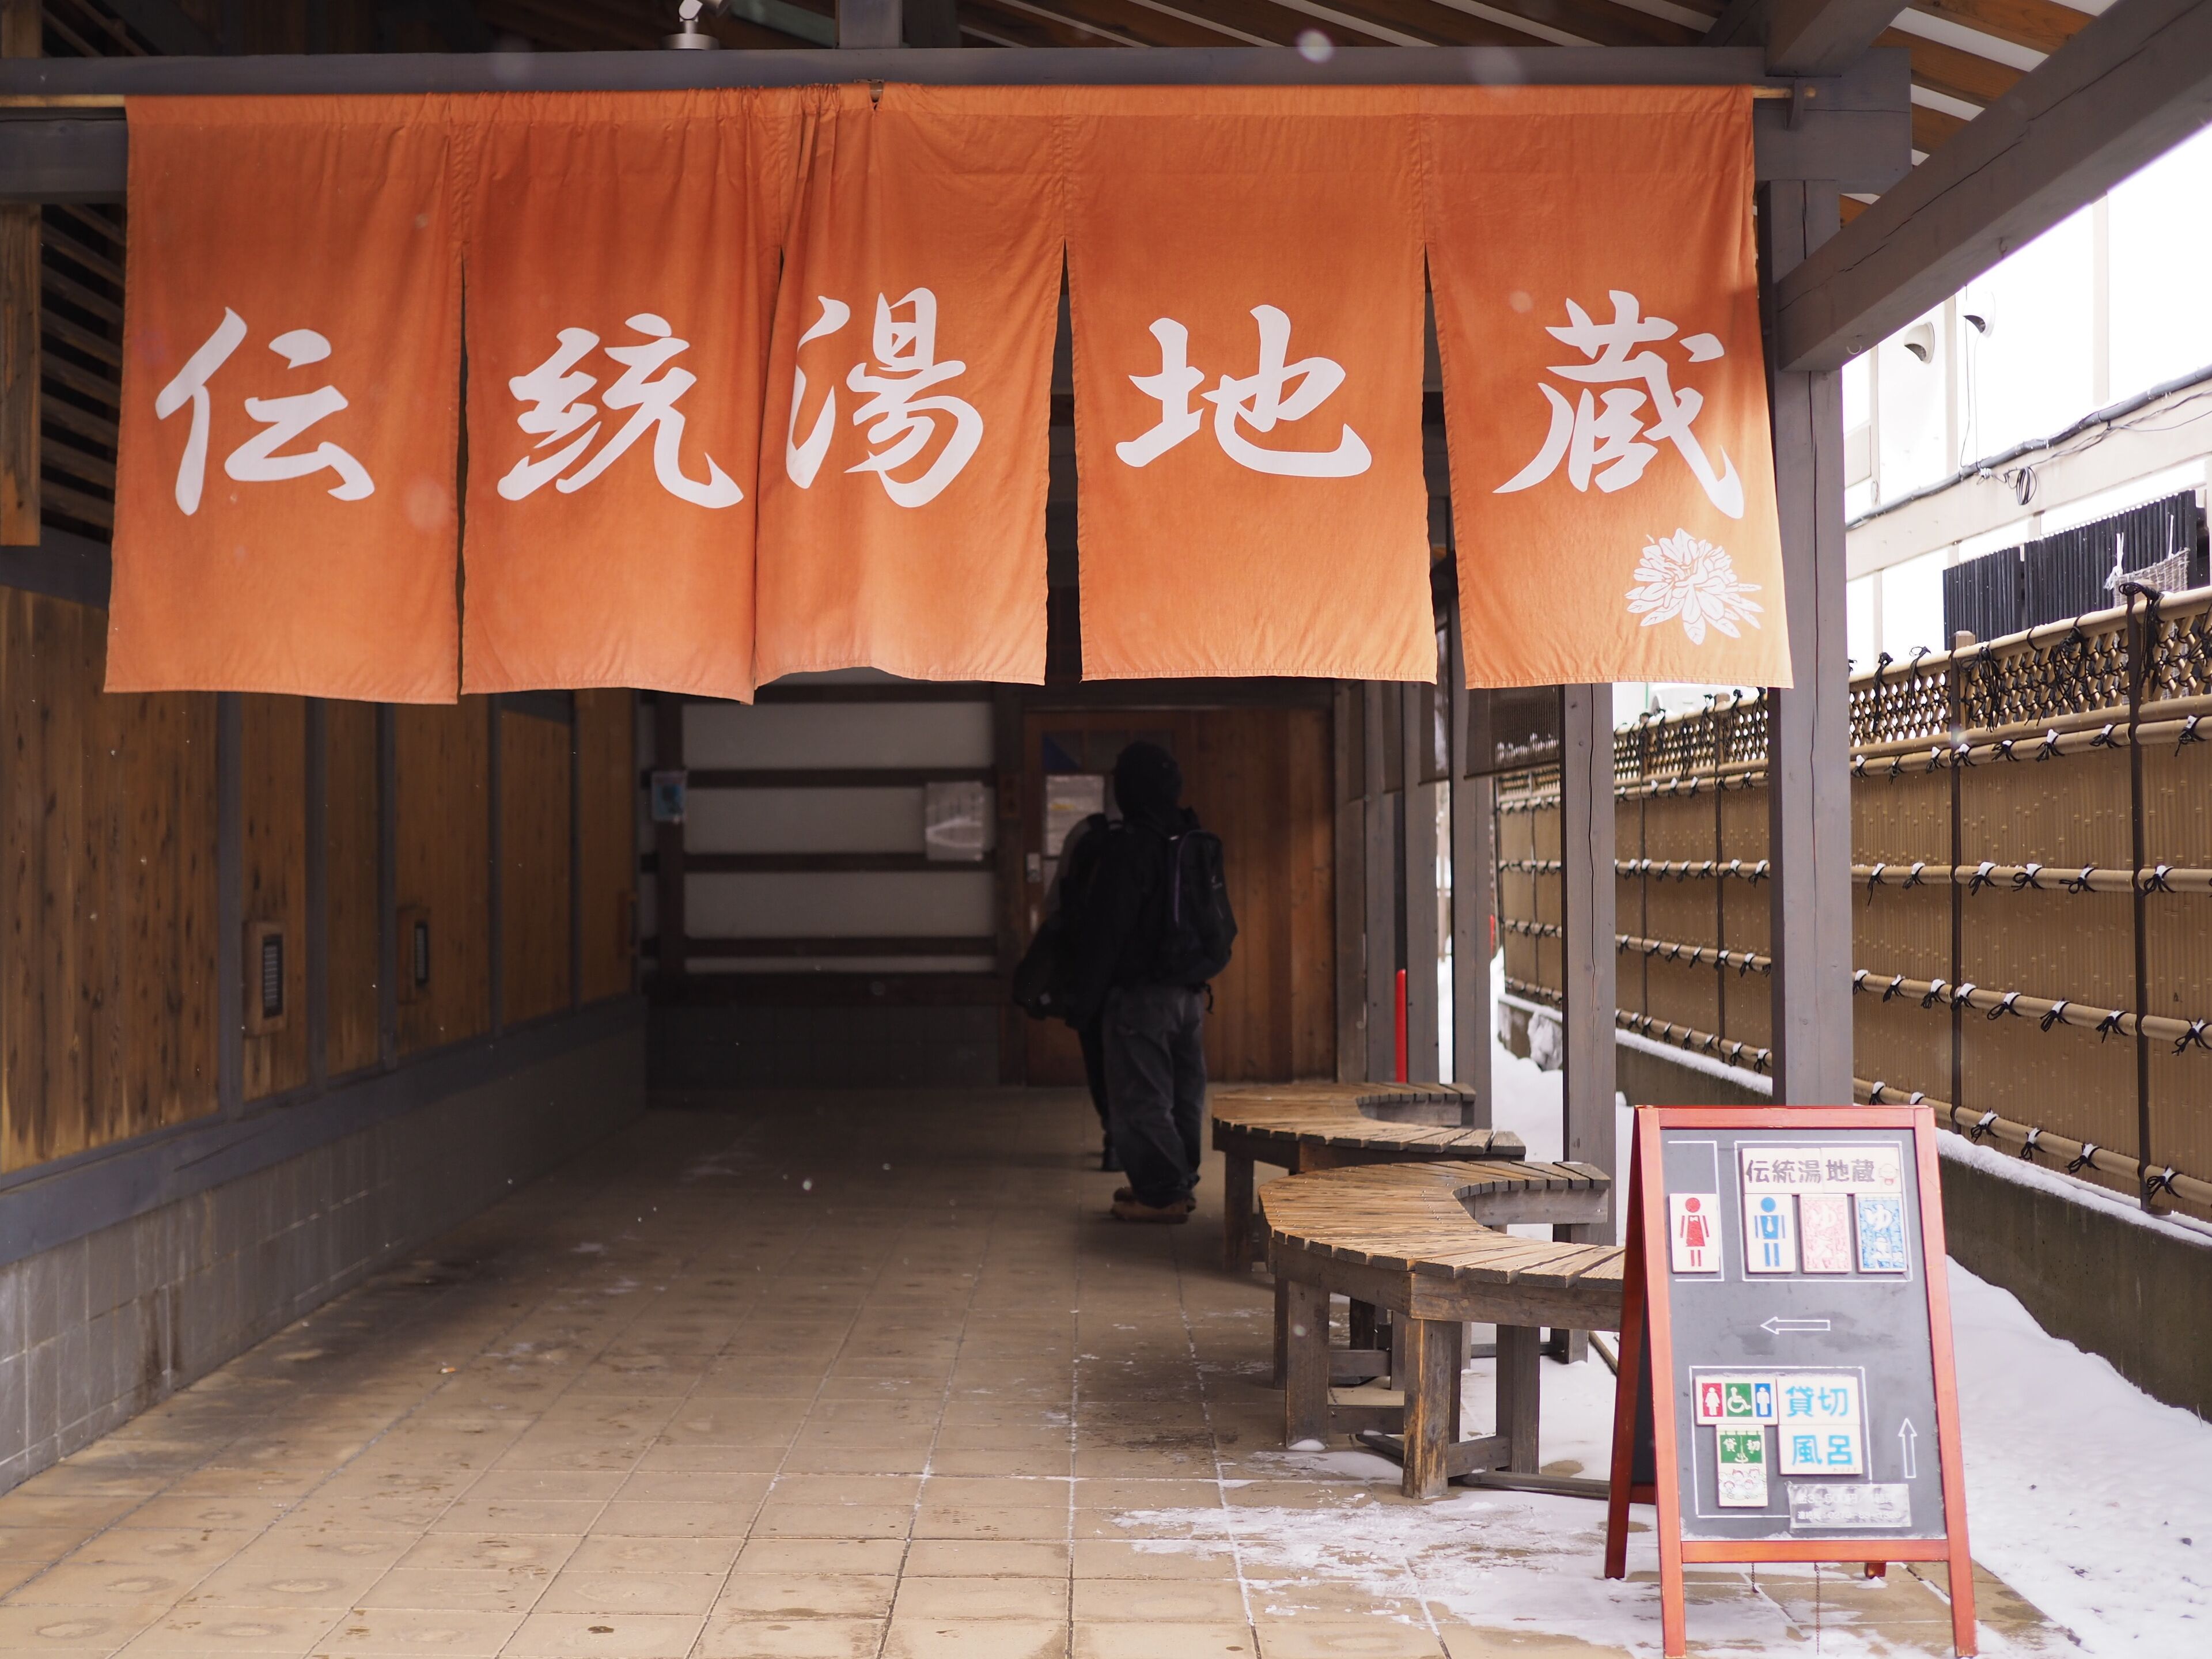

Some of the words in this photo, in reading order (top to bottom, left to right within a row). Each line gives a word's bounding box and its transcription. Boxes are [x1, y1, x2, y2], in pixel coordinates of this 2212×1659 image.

[154, 286, 1745, 520] 伝統湯地蔵
[1745, 1158, 1875, 1184] 伝統湯地蔵
[1863, 1204, 1893, 1231] ゆ
[1785, 1385, 1849, 1417] 貸切
[1792, 1434, 1854, 1466] 風呂
